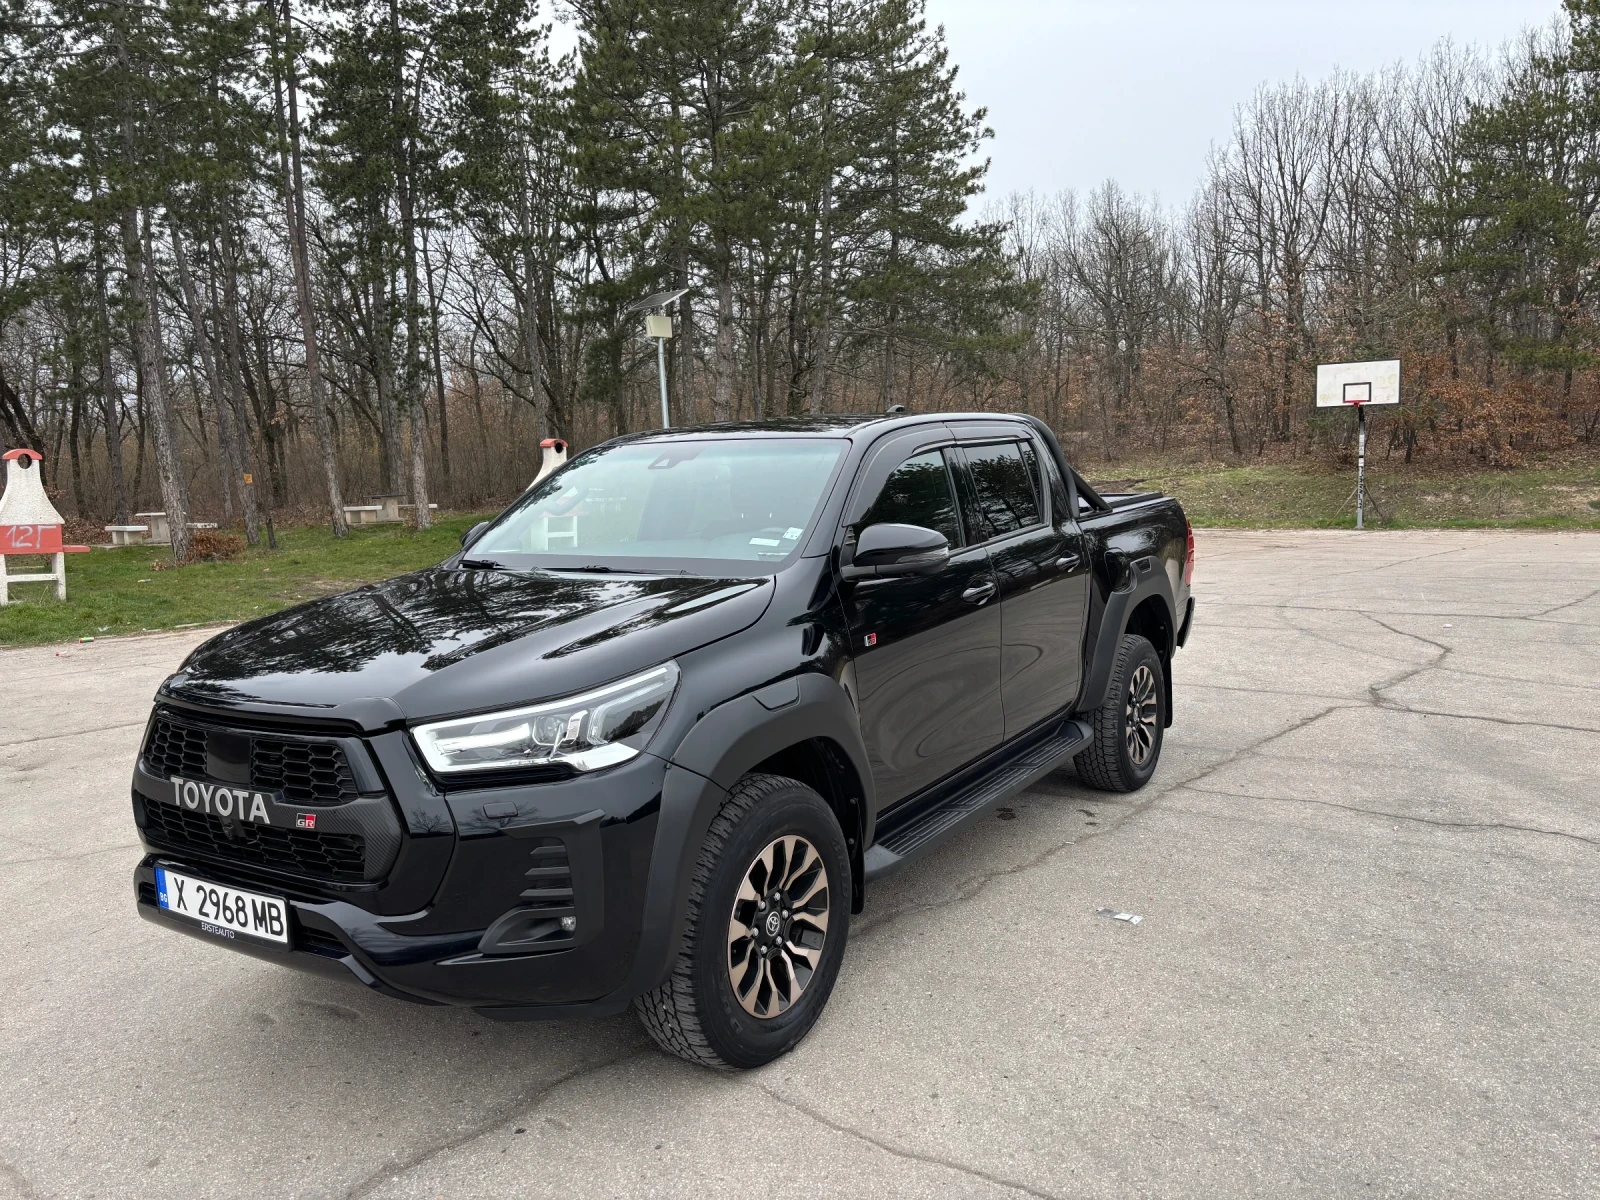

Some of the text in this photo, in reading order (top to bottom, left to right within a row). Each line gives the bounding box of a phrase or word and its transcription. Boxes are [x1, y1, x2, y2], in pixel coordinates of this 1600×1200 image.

[170, 776, 271, 824] TOYOTA
[160, 891, 168, 903] BG
[173, 877, 284, 937] X 2968 MB
